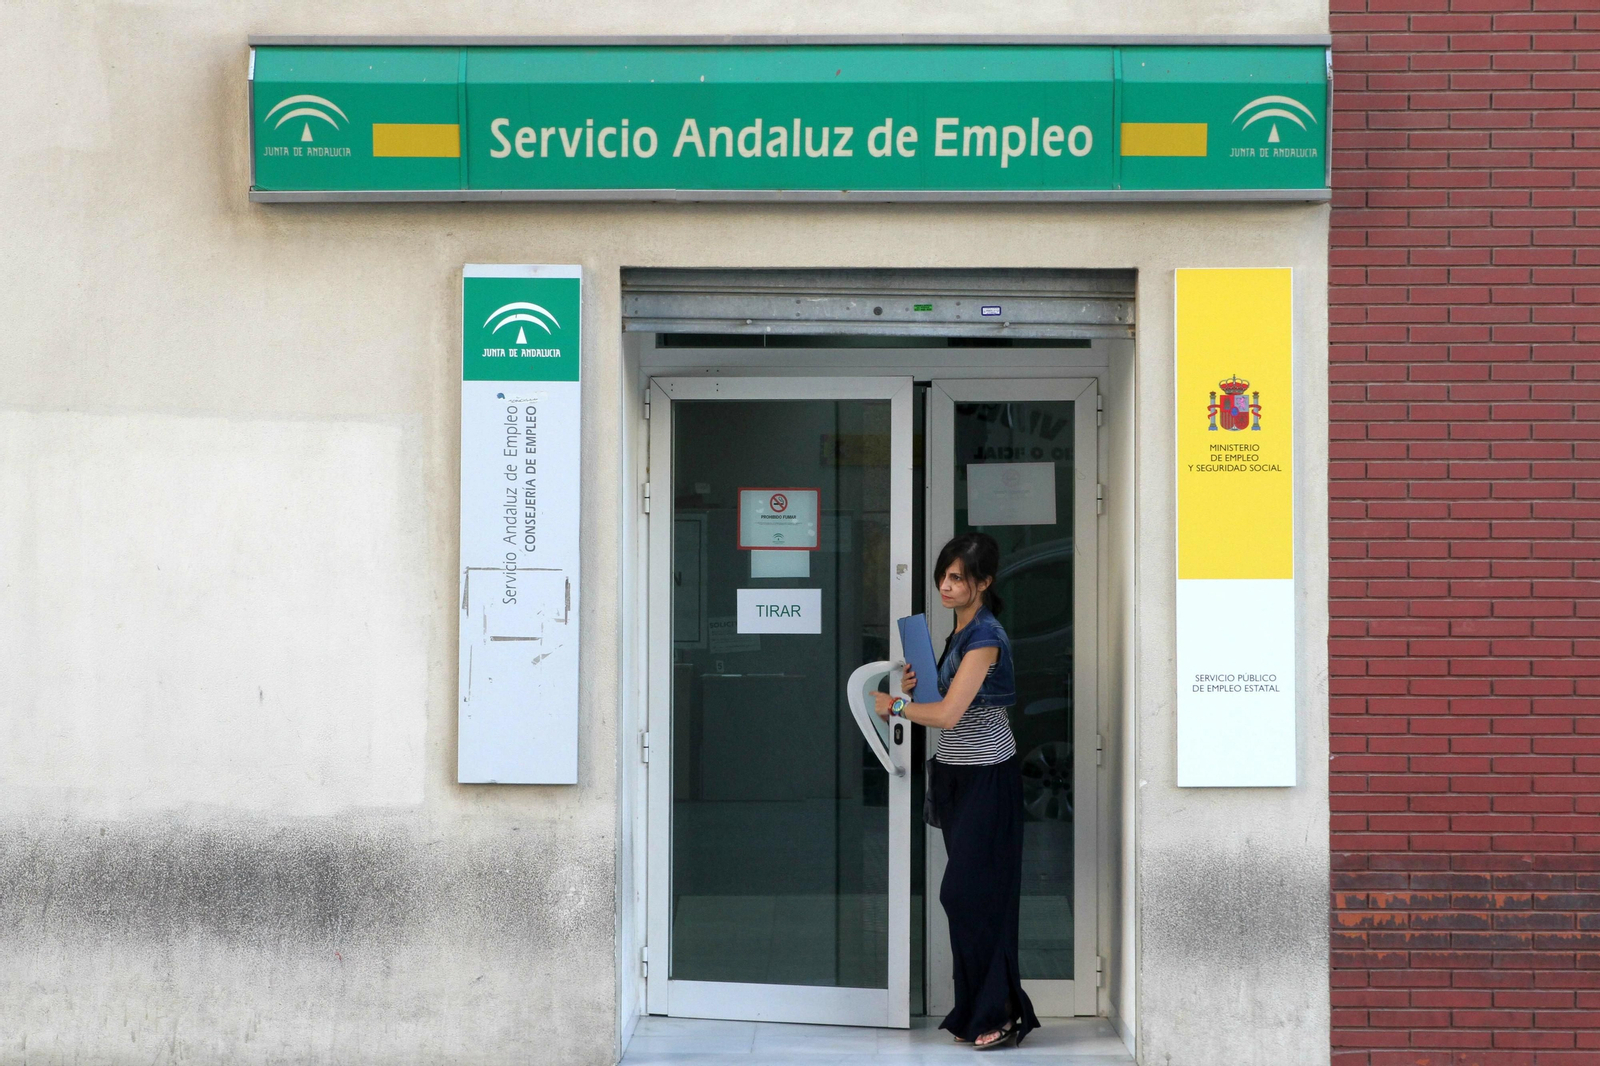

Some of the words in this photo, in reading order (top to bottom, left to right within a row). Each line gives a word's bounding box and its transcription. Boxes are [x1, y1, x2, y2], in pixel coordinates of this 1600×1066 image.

[490, 117, 658, 159] Servicio
[672, 117, 854, 159] Andaluz
[867, 117, 918, 159] de
[934, 116, 1093, 169] Empleo
[263, 146, 290, 157] JUNTA
[292, 146, 303, 157] DE
[307, 146, 351, 157] ANDALUCIA
[1229, 147, 1256, 158] JUNTA
[1259, 147, 1269, 158] DE
[1273, 147, 1318, 158] ANDALUCIA
[482, 348, 506, 358] JUNTA
[508, 348, 518, 358] DE
[520, 348, 561, 358] ANDALUCIA
[503, 405, 521, 457] Empleo
[525, 405, 537, 454] EMPLEO
[1209, 443, 1260, 452] MINISTERIO
[1210, 453, 1223, 462] DE
[1224, 453, 1260, 462] EMPLEO
[503, 464, 518, 481] de
[525, 458, 537, 475] DE
[1187, 464, 1194, 472] Y
[1195, 464, 1248, 472] SEGURIDAD
[1249, 464, 1282, 472] SOCIAL
[503, 487, 518, 546] Andaluz
[522, 478, 537, 553] CONSEJERÍA
[502, 552, 517, 605] Servicio
[755, 604, 802, 618] TIRAR
[1194, 674, 1236, 682] SERVICIO
[1237, 673, 1277, 682] PÚBLICO
[1192, 684, 1205, 693] DE
[1206, 684, 1242, 693] EMPLEO
[1244, 684, 1280, 693] ESTATAL
